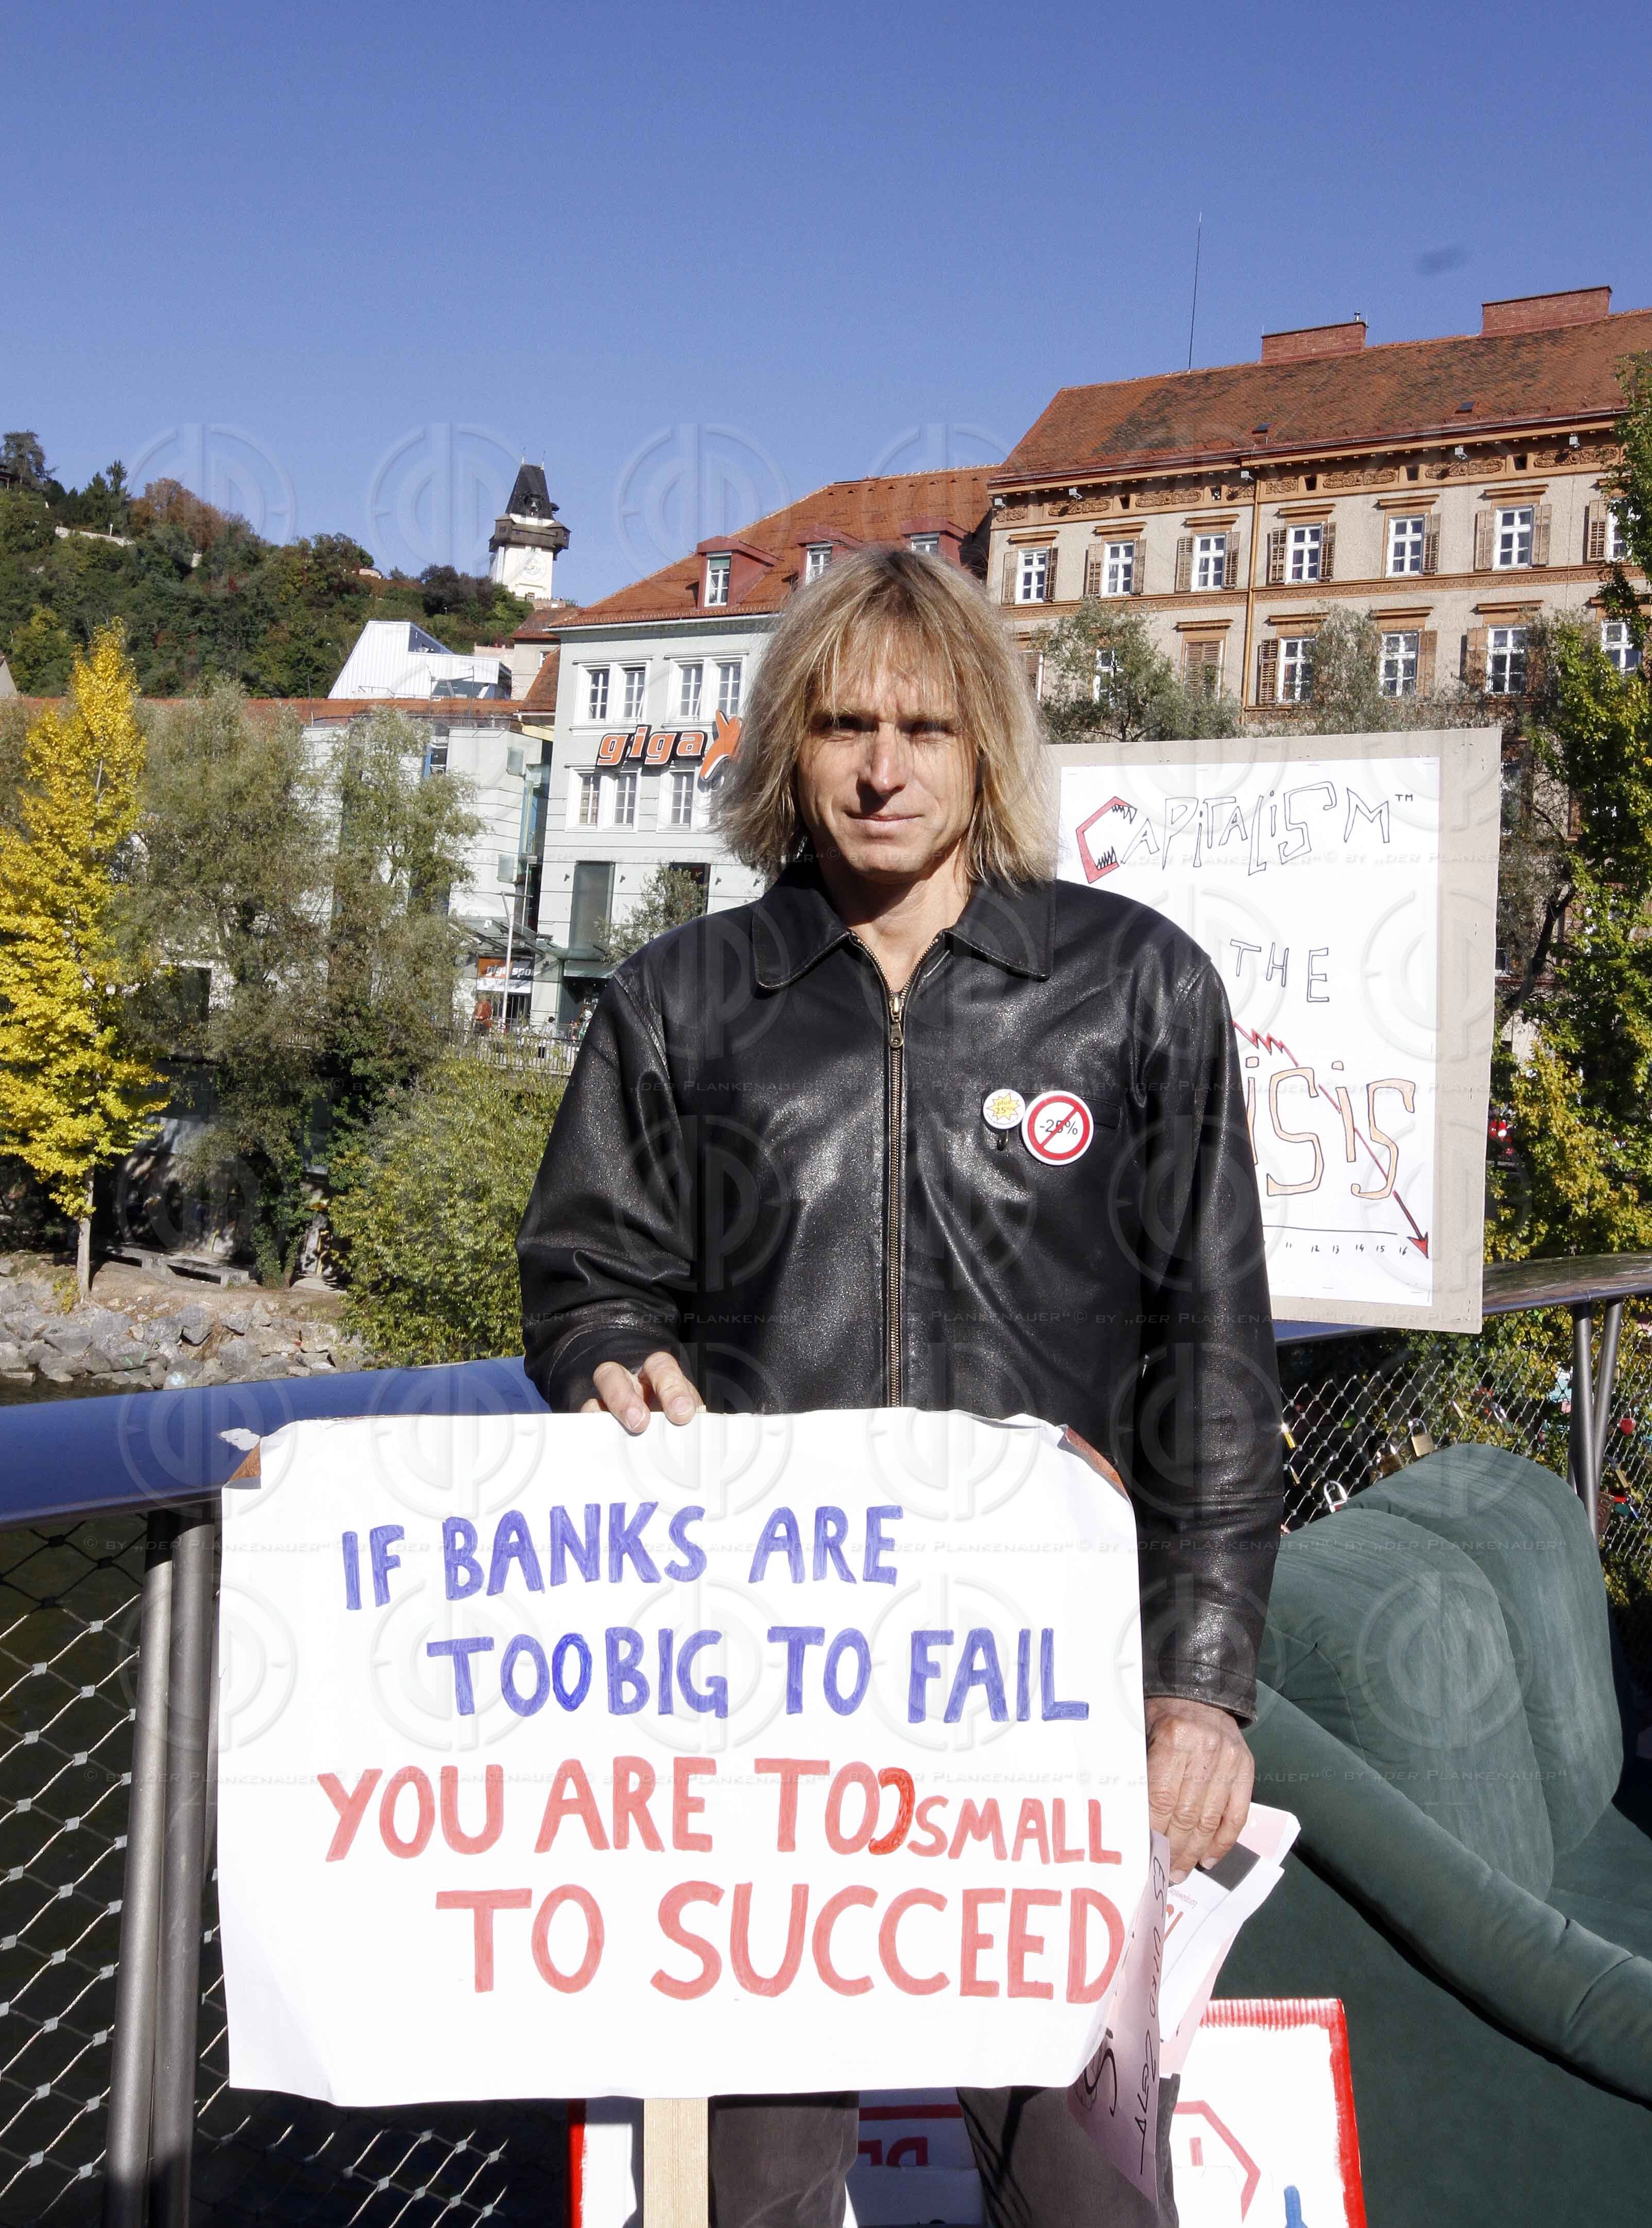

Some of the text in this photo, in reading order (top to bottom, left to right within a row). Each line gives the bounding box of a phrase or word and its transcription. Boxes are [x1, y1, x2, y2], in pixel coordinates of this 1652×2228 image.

[596, 725, 708, 766] giga
[1230, 939, 1330, 1002] THE
[342, 1501, 903, 1610] IF BANKS ARE
[427, 1626, 1089, 1723] TOO BIG TO FAIL
[317, 1764, 504, 1862] YOU
[534, 1756, 717, 1853] ARE
[907, 1795, 1122, 1865] SMALL
[436, 1880, 1126, 2004] TO SUCCEED
